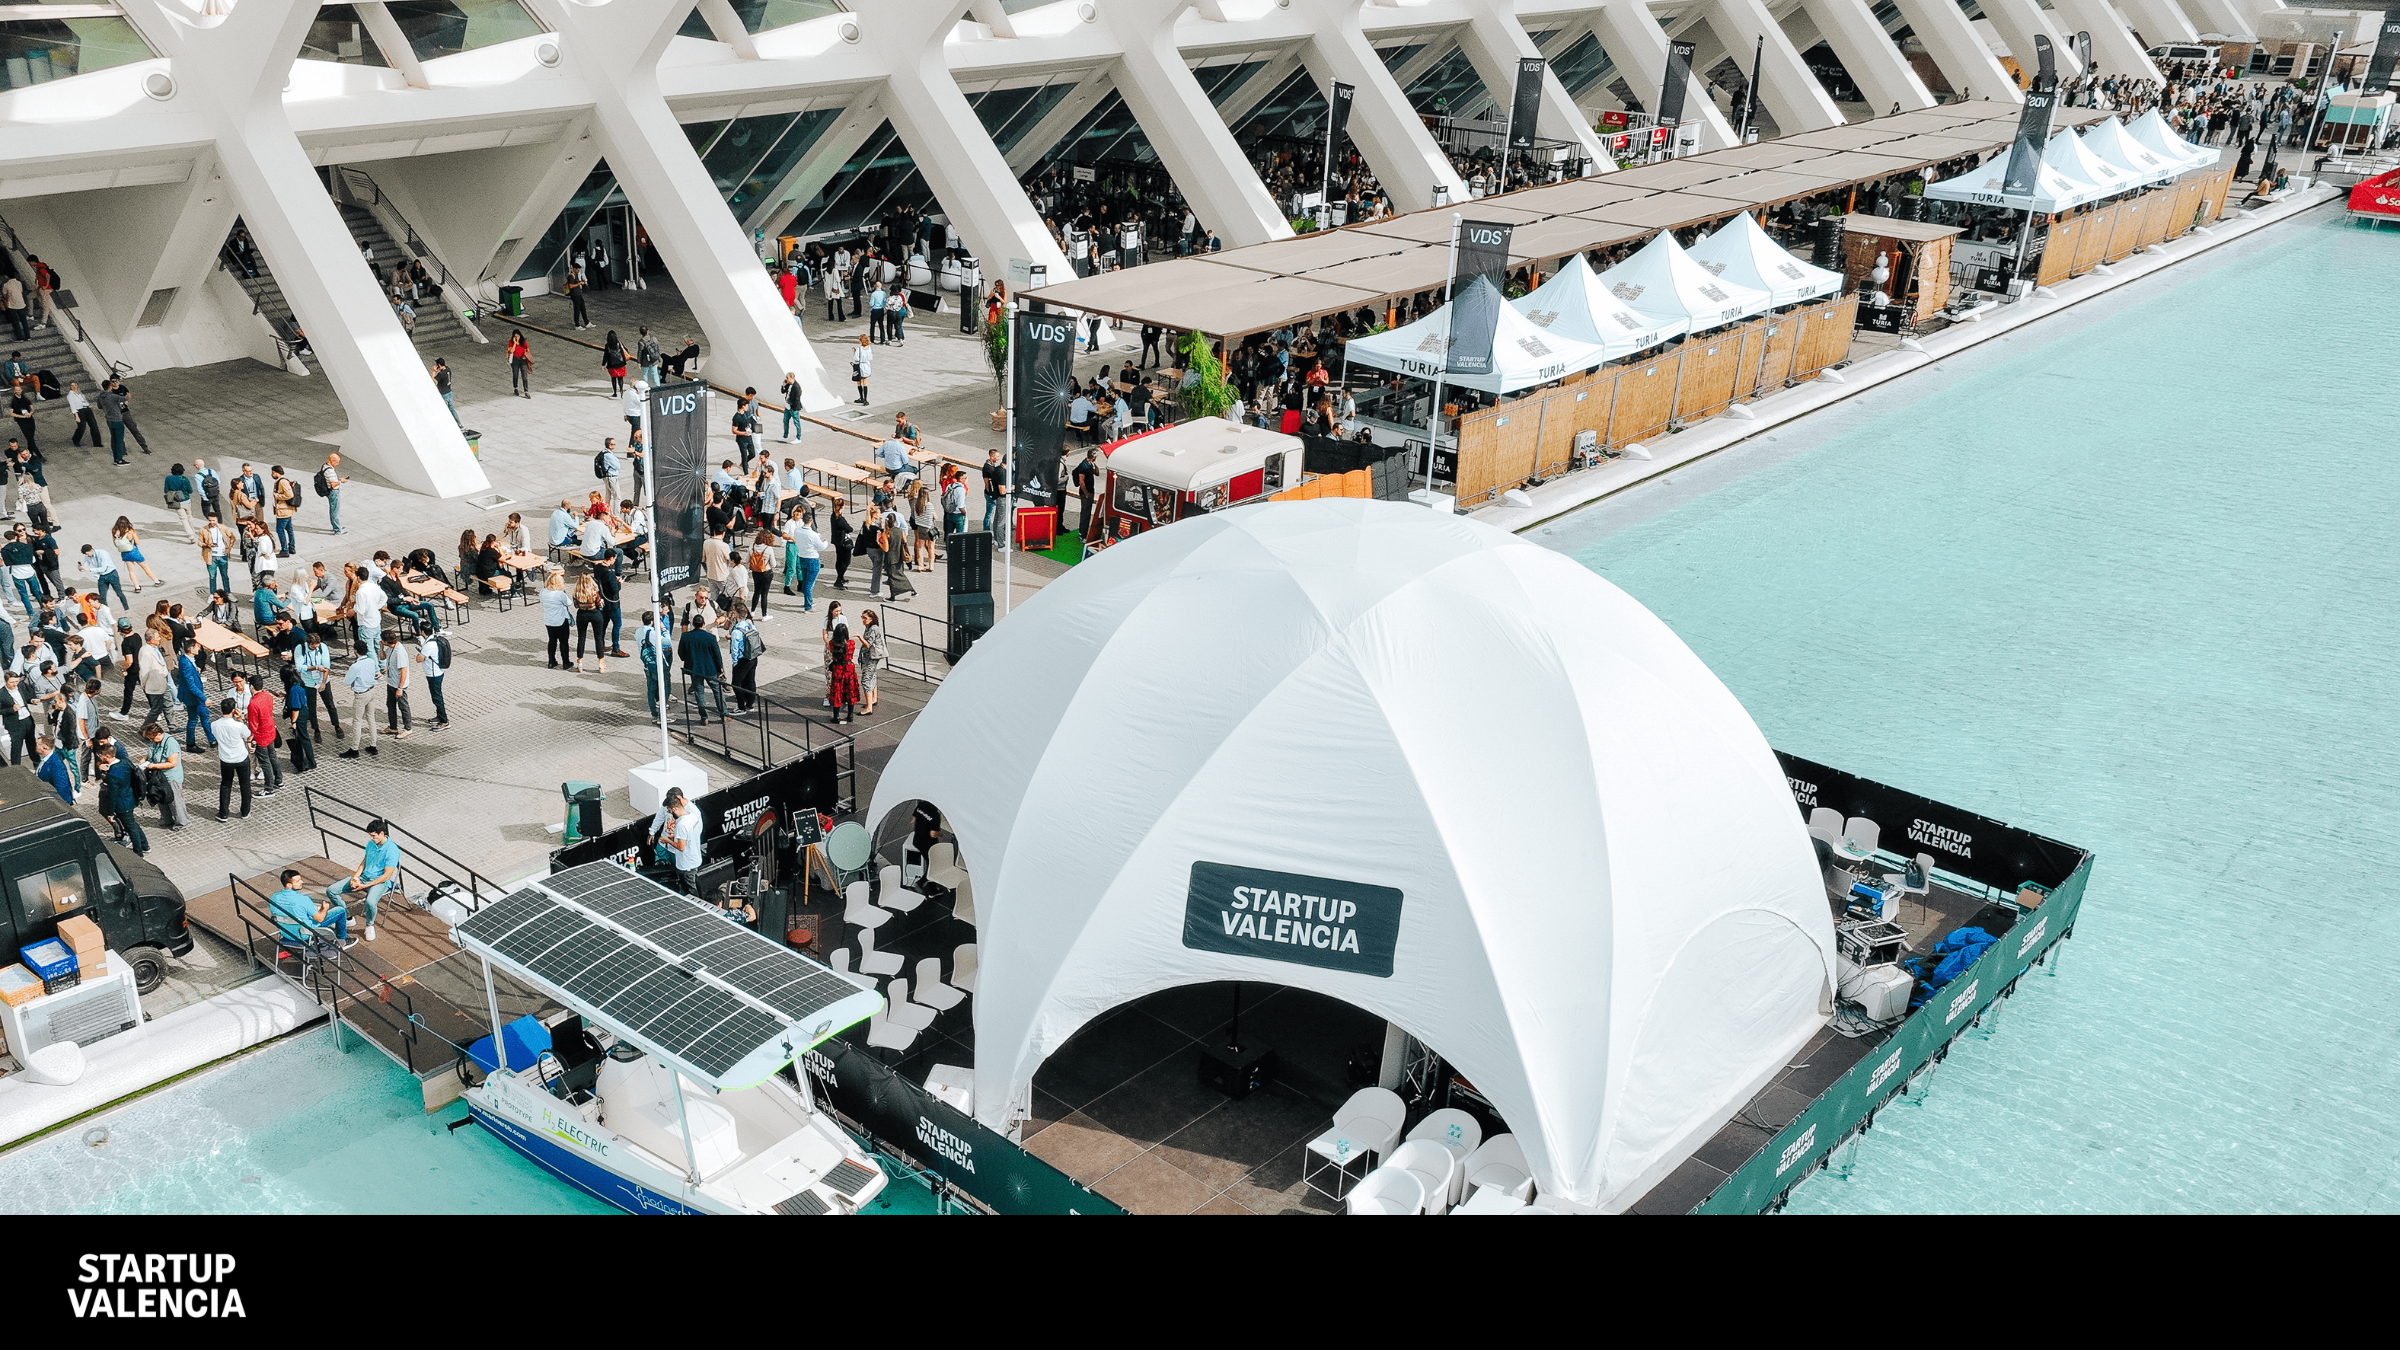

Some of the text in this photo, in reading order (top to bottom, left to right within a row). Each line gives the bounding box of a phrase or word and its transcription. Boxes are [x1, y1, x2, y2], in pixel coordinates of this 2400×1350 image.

[1674, 45, 1695, 56] VDS+
[1523, 61, 1544, 72] VDS+
[1971, 192, 2005, 205] TURIA
[1469, 227, 1512, 246] VDS+
[1983, 276, 2001, 287] TURIA
[1797, 284, 1816, 299] TURIA
[1721, 305, 1743, 322] TURIA
[1872, 318, 1892, 328] TURIA
[1029, 322, 1074, 343] VDS+
[1635, 331, 1659, 349] TURIA
[1456, 361, 1487, 369] VALENCIA
[1458, 355, 1486, 363] STARTUP
[1538, 362, 1567, 381] TURIA
[659, 386, 707, 416] VDS+
[1433, 462, 1451, 473] URIA
[1022, 484, 1052, 499] Santander
[660, 565, 690, 580] STARTUP
[1786, 776, 1818, 795] RTUP
[723, 795, 771, 822] STARTUP
[721, 807, 768, 834] VALENC
[1912, 818, 1972, 844] STARTUP
[1907, 827, 1972, 859] VALENCIA
[603, 845, 640, 865] RTUP
[1230, 885, 1357, 924] STARTUP
[1221, 910, 1360, 954] VALENCIA
[805, 1049, 836, 1070] RTUP
[805, 1058, 839, 1089] ENCIA
[501, 1097, 533, 1123] PROTOTYPE
[919, 1115, 972, 1156] STARTUP
[1780, 1122, 1817, 1164] STARTUP
[915, 1126, 976, 1175] VALENCIA
[1775, 1135, 1815, 1179] VALENCIA
